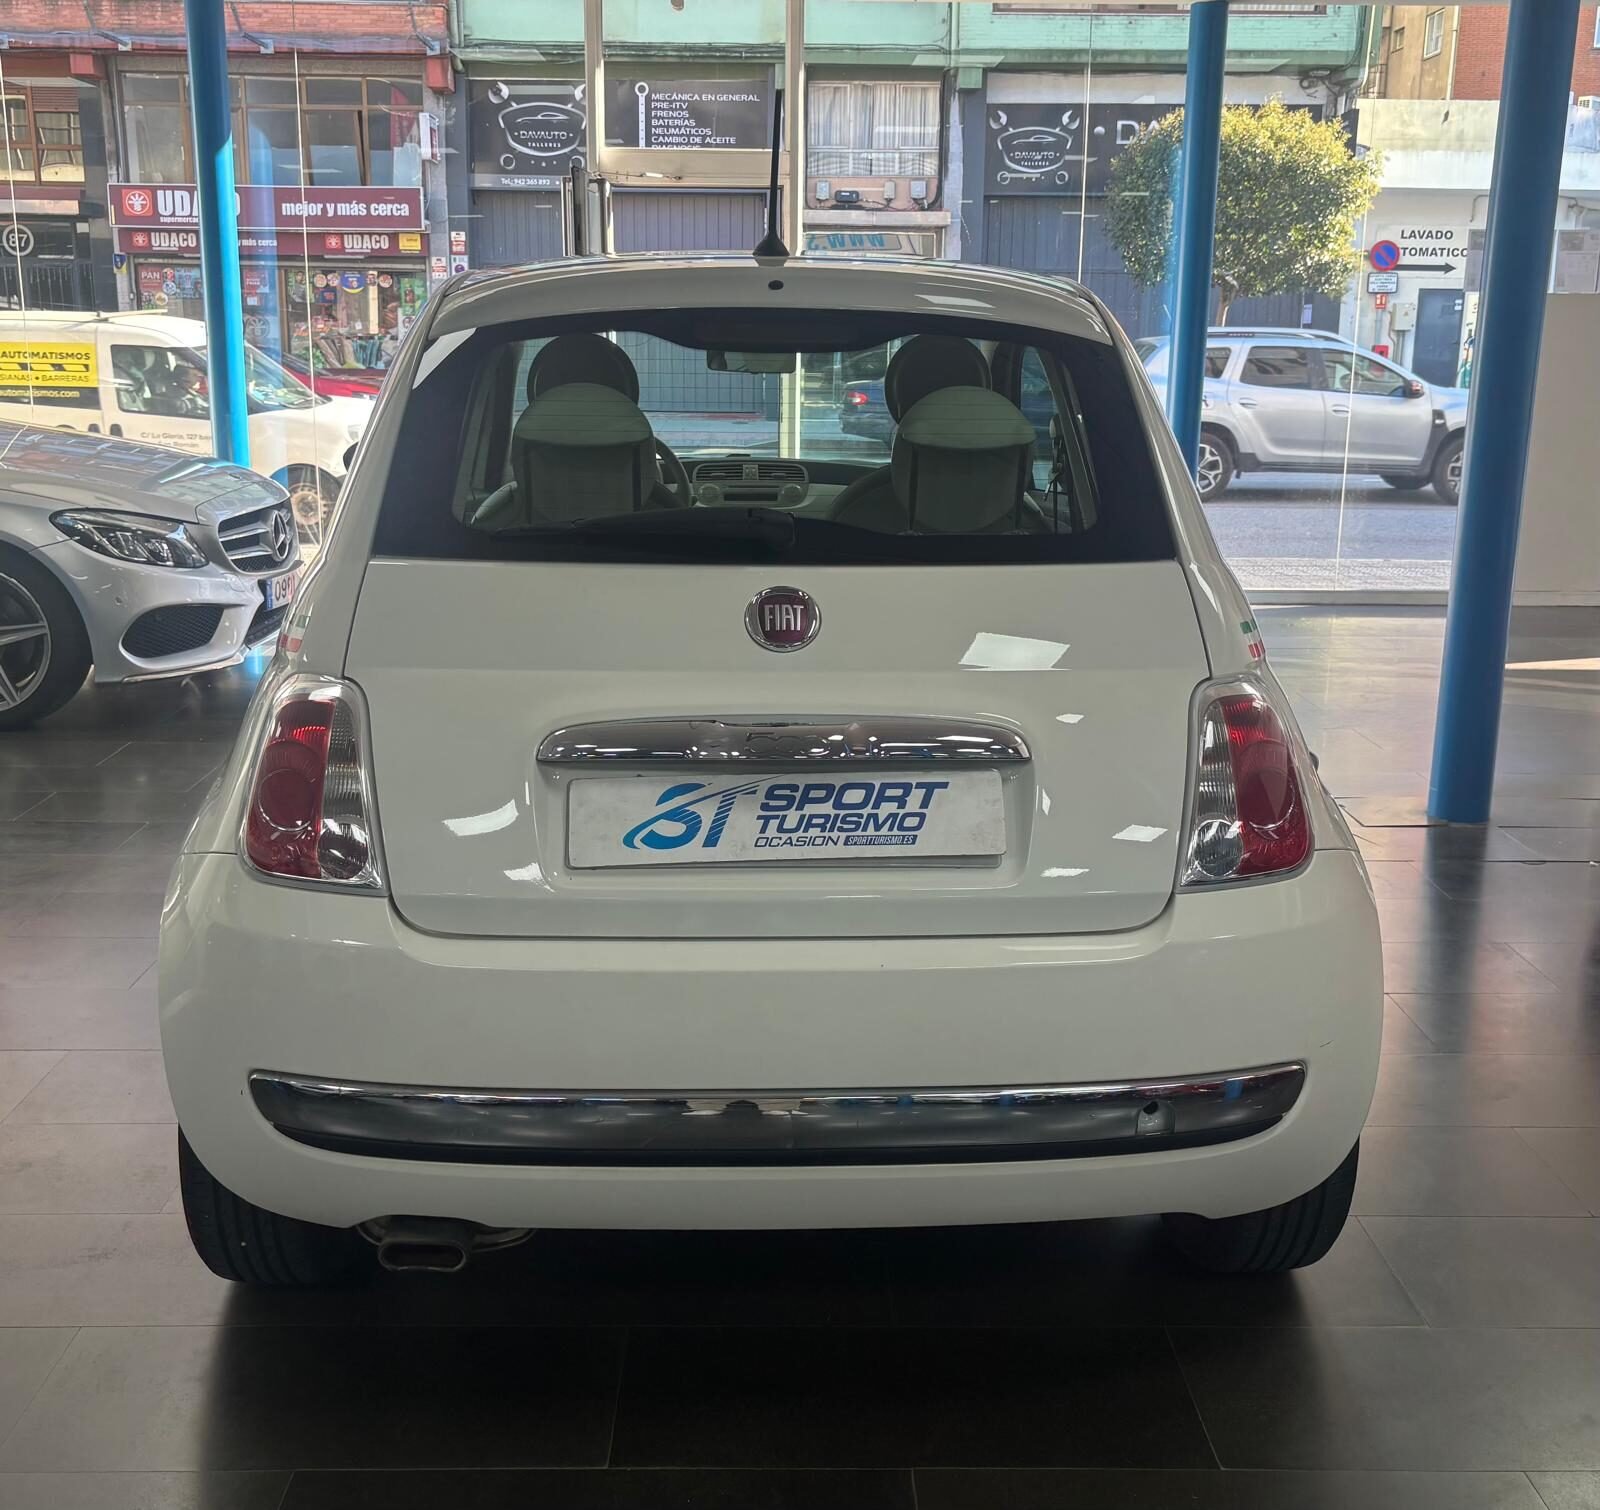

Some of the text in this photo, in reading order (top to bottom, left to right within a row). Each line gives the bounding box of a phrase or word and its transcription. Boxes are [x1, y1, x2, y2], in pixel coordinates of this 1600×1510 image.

[651, 92, 700, 101] MECÁNICA
[716, 94, 760, 102] GENERAL
[651, 110, 689, 118] FRENOS
[651, 118, 696, 127] BATERÍAS
[520, 131, 567, 139] DAVAUTO
[651, 127, 712, 135] NEUMÁTICOS
[690, 136, 702, 144] DE
[281, 200, 409, 217] mejor y más cerca
[9, 233, 27, 247] 87
[151, 232, 197, 247] UDACO
[1400, 230, 1454, 240] LAVADO
[344, 235, 389, 249] UDACO
[1401, 247, 1467, 257] TOMATICO
[141, 271, 160, 279] PAN
[1, 351, 91, 360] AUTOMATISMOS
[764, 604, 804, 631] FIAT
[760, 782, 949, 812] SPORT
[756, 812, 927, 834] TURISMO
[754, 834, 914, 847] OCASION SPORTTURISMO.ES
